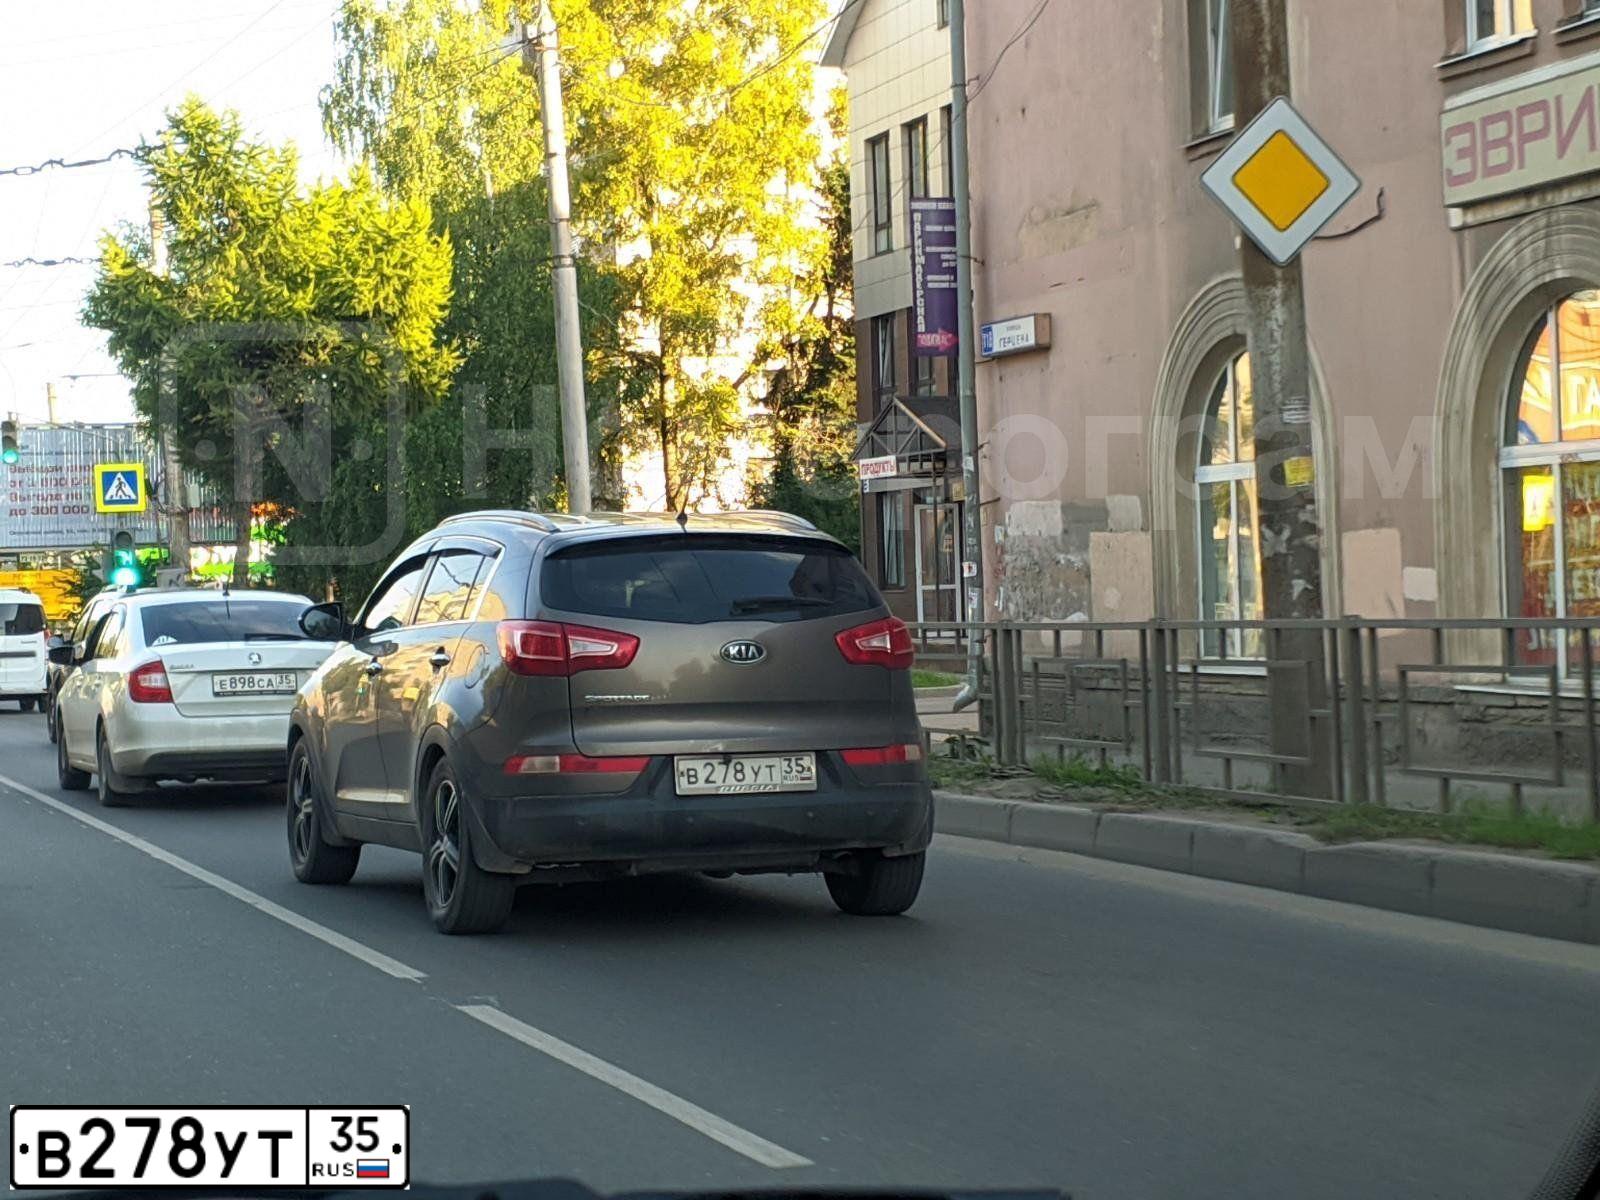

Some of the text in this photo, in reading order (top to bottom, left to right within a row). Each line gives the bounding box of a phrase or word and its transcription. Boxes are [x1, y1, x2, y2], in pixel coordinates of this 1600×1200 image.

[1445, 84, 1597, 187] ЭВРИ
[999, 333, 1029, 348] ГЕРЦЕНА
[729, 645, 759, 659] KIA
[277, 674, 291, 685] 35
[686, 757, 805, 785] В278УТ 35
